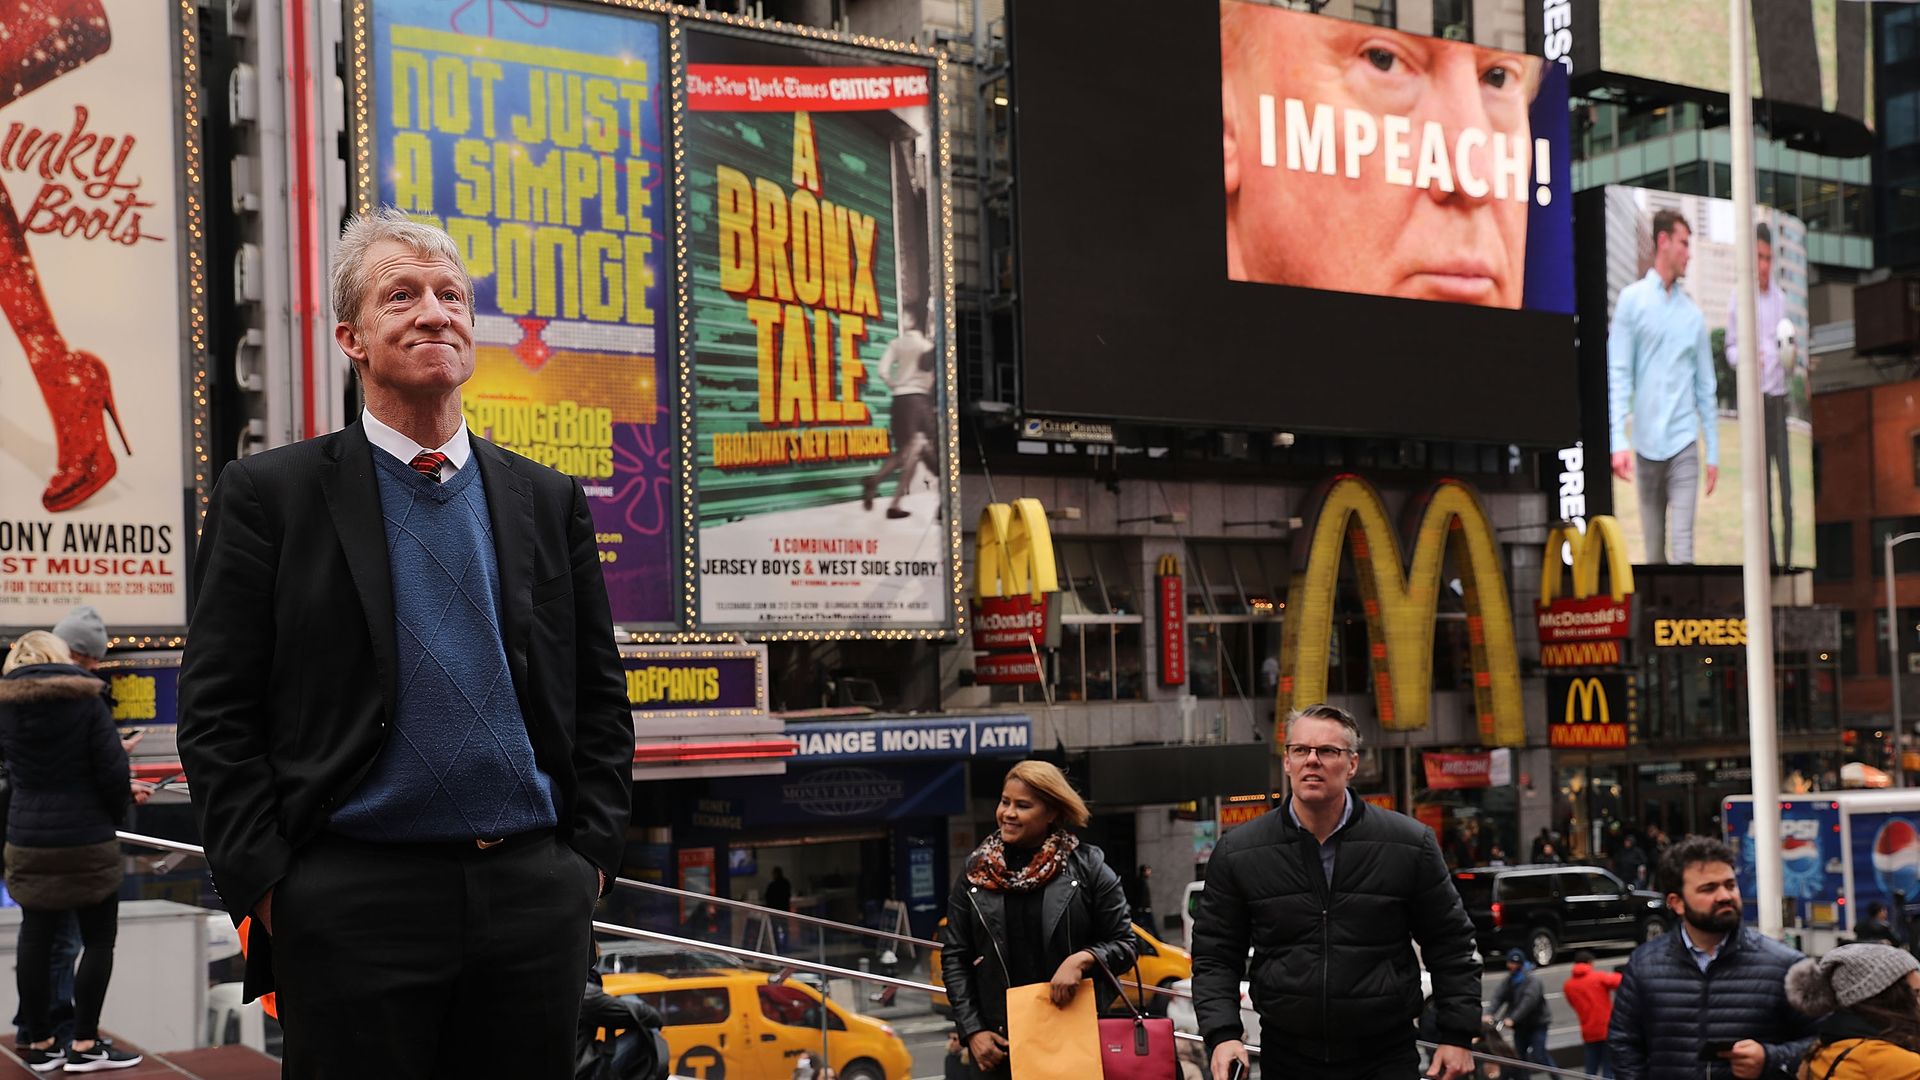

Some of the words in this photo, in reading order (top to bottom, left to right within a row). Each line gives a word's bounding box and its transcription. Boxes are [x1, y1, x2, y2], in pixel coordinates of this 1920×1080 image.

[391, 48, 504, 139] NOT
[511, 69, 648, 157] JUST
[686, 75, 713, 97] The
[714, 77, 747, 96] New
[747, 77, 784, 101] York
[784, 77, 828, 99] Times
[829, 77, 892, 100] CRITICS'
[893, 75, 928, 98] PICK
[792, 110, 822, 194] A
[1259, 93, 1552, 207] IMPEACH!
[393, 132, 433, 212] A
[453, 138, 653, 234] SIMPLE
[24, 184, 166, 245] Boots
[716, 164, 881, 318] BRONX
[403, 214, 655, 325] PONGE
[746, 298, 869, 425] TALE
[712, 430, 800, 467] BROADWAY'S
[800, 429, 827, 460] NEW
[827, 428, 847, 458] HIT
[848, 426, 890, 455] MUSICAL
[63, 523, 173, 554] AWARDS
[783, 538, 863, 554] COMBINATION
[865, 539, 878, 554] OF
[3, 556, 38, 574] ST
[47, 558, 173, 576] MUSICAL
[702, 559, 757, 575] JERSEY
[762, 559, 801, 575] BOYS
[803, 559, 814, 575] &
[818, 559, 857, 576] WEST
[860, 560, 891, 576] SIDE
[1538, 607, 1626, 628] McDonald's
[882, 727, 967, 751] MONEY
[980, 725, 1028, 747] ATM
